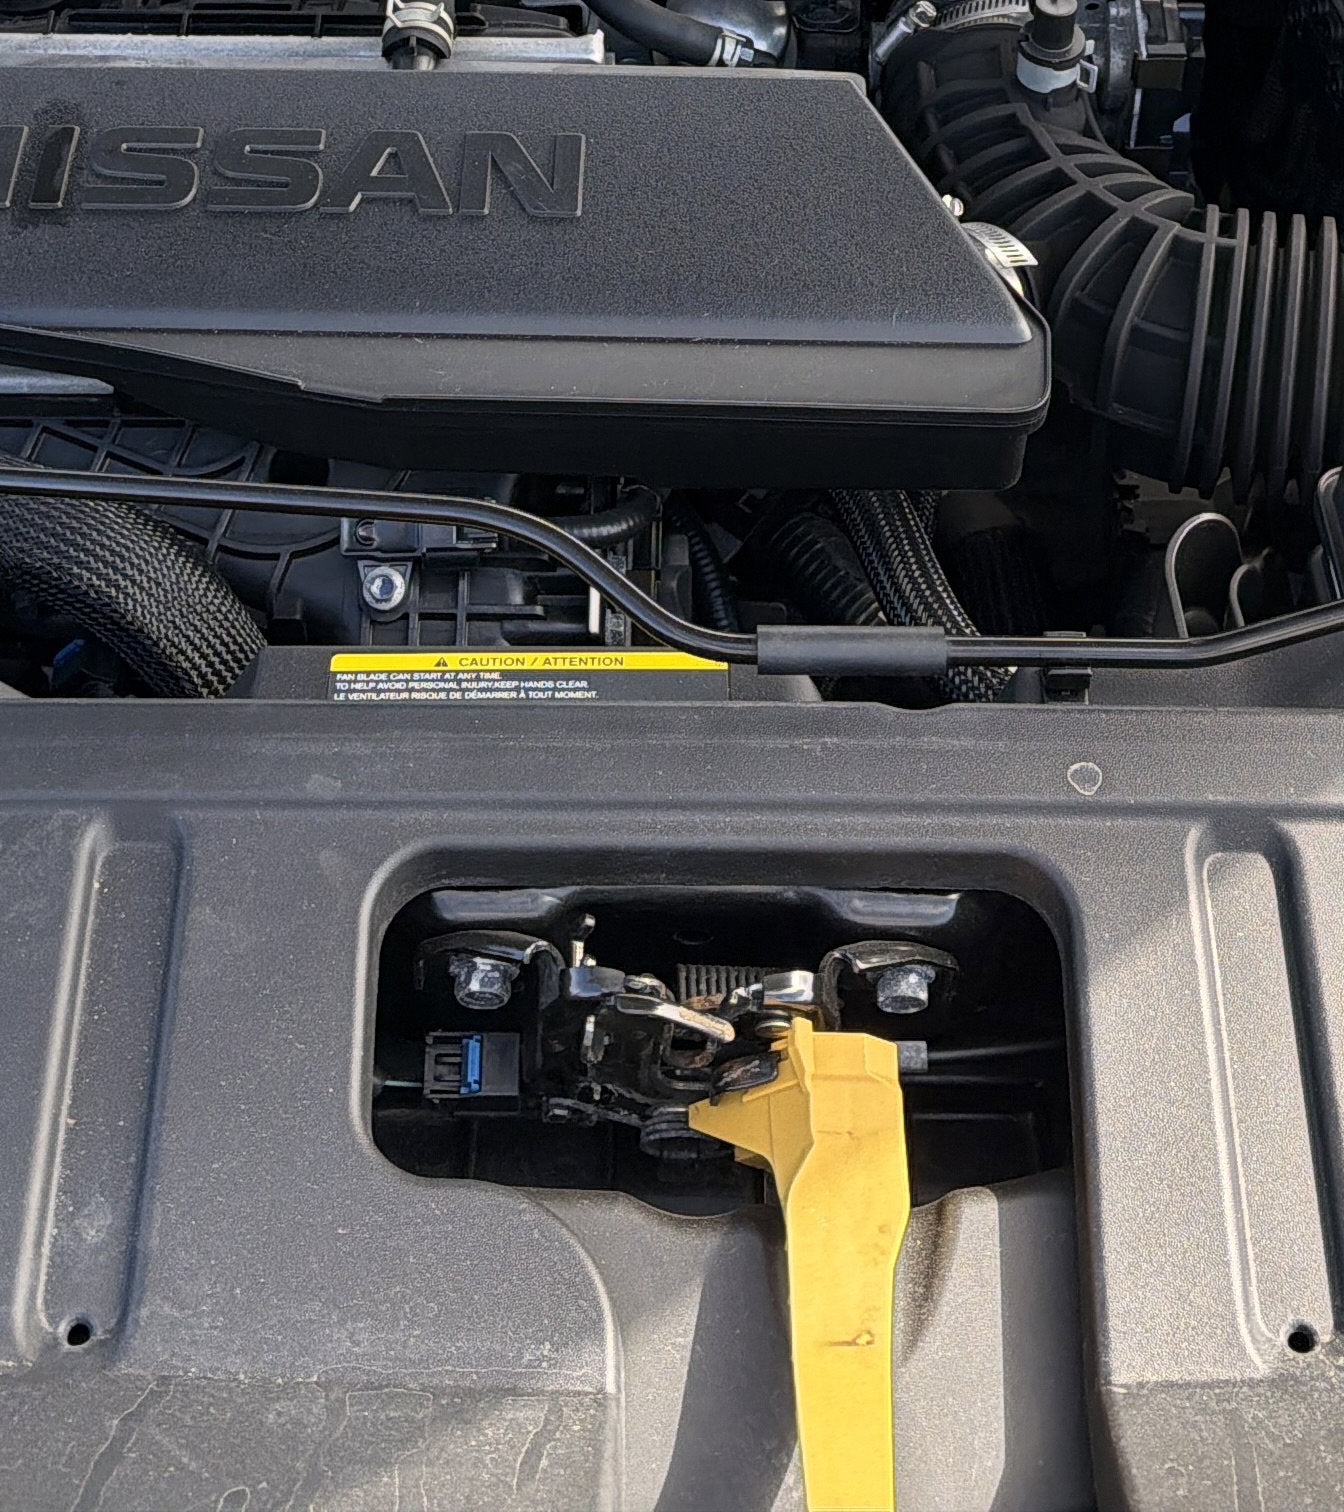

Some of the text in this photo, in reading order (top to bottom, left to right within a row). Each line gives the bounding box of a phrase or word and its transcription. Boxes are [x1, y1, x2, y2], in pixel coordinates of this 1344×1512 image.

[458, 656, 526, 667] CAUTION
[543, 656, 625, 667] ATTENTION
[336, 672, 355, 681] FAN
[357, 672, 388, 681] BLADE
[390, 672, 411, 681] CAN
[413, 672, 442, 681] START
[444, 672, 456, 681] AT
[457, 672, 477, 681] ANY
[335, 681, 348, 690] TO
[350, 681, 375, 690] HELP
[377, 681, 406, 690] AVOID
[408, 681, 459, 690] PERSONAL
[521, 681, 554, 690] HANDS
[334, 691, 346, 701] LE
[348, 691, 407, 701] VENTILATEUR
[411, 691, 446, 701] RISQUE
[449, 691, 462, 701] DE
[465, 689, 517, 701] DÉMARRER
[519, 689, 526, 701] À
[528, 691, 553, 701] TOUT
